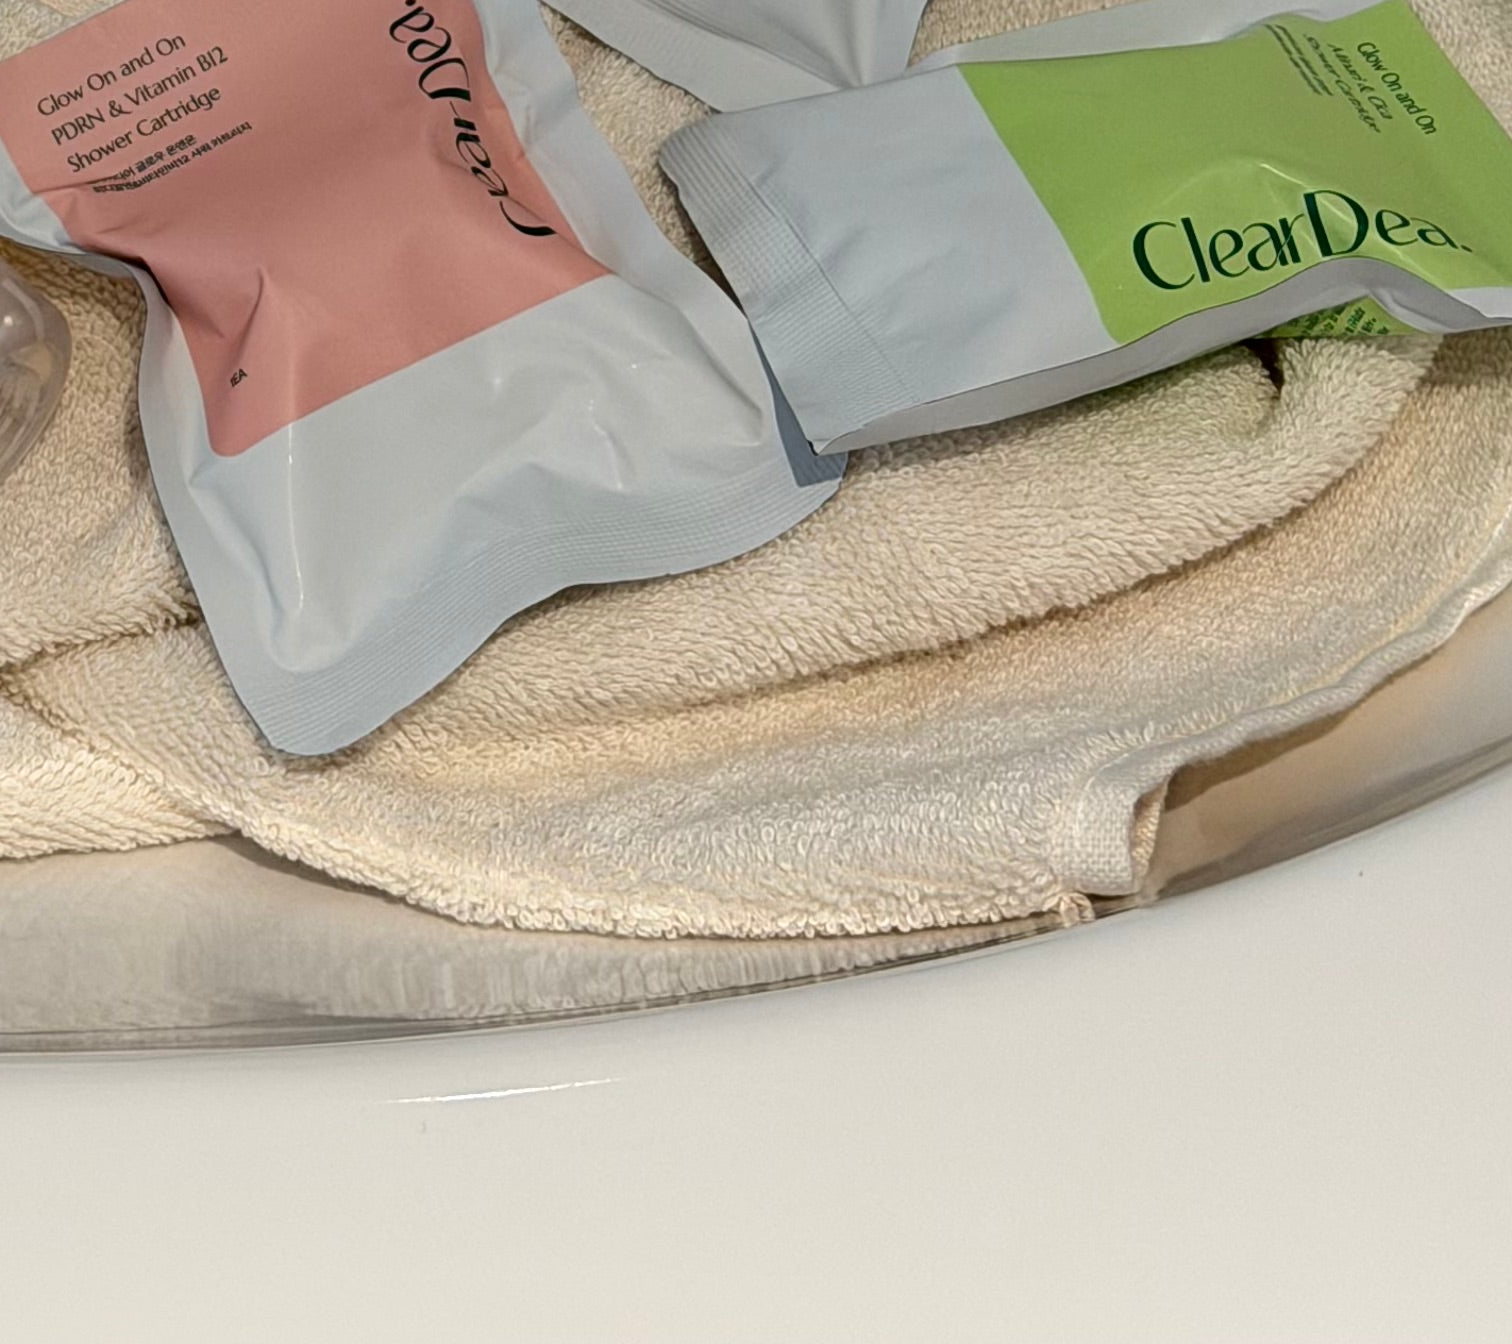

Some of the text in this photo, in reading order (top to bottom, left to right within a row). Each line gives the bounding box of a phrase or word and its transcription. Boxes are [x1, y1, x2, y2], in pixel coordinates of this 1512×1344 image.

[37, 35, 187, 117] Glow On and On
[50, 45, 229, 146] PDRN & Vitamin B12
[1357, 41, 1437, 135] Glow On and On
[66, 87, 222, 174] Shower Cartridge
[1132, 189, 1473, 291] ClearDea.
